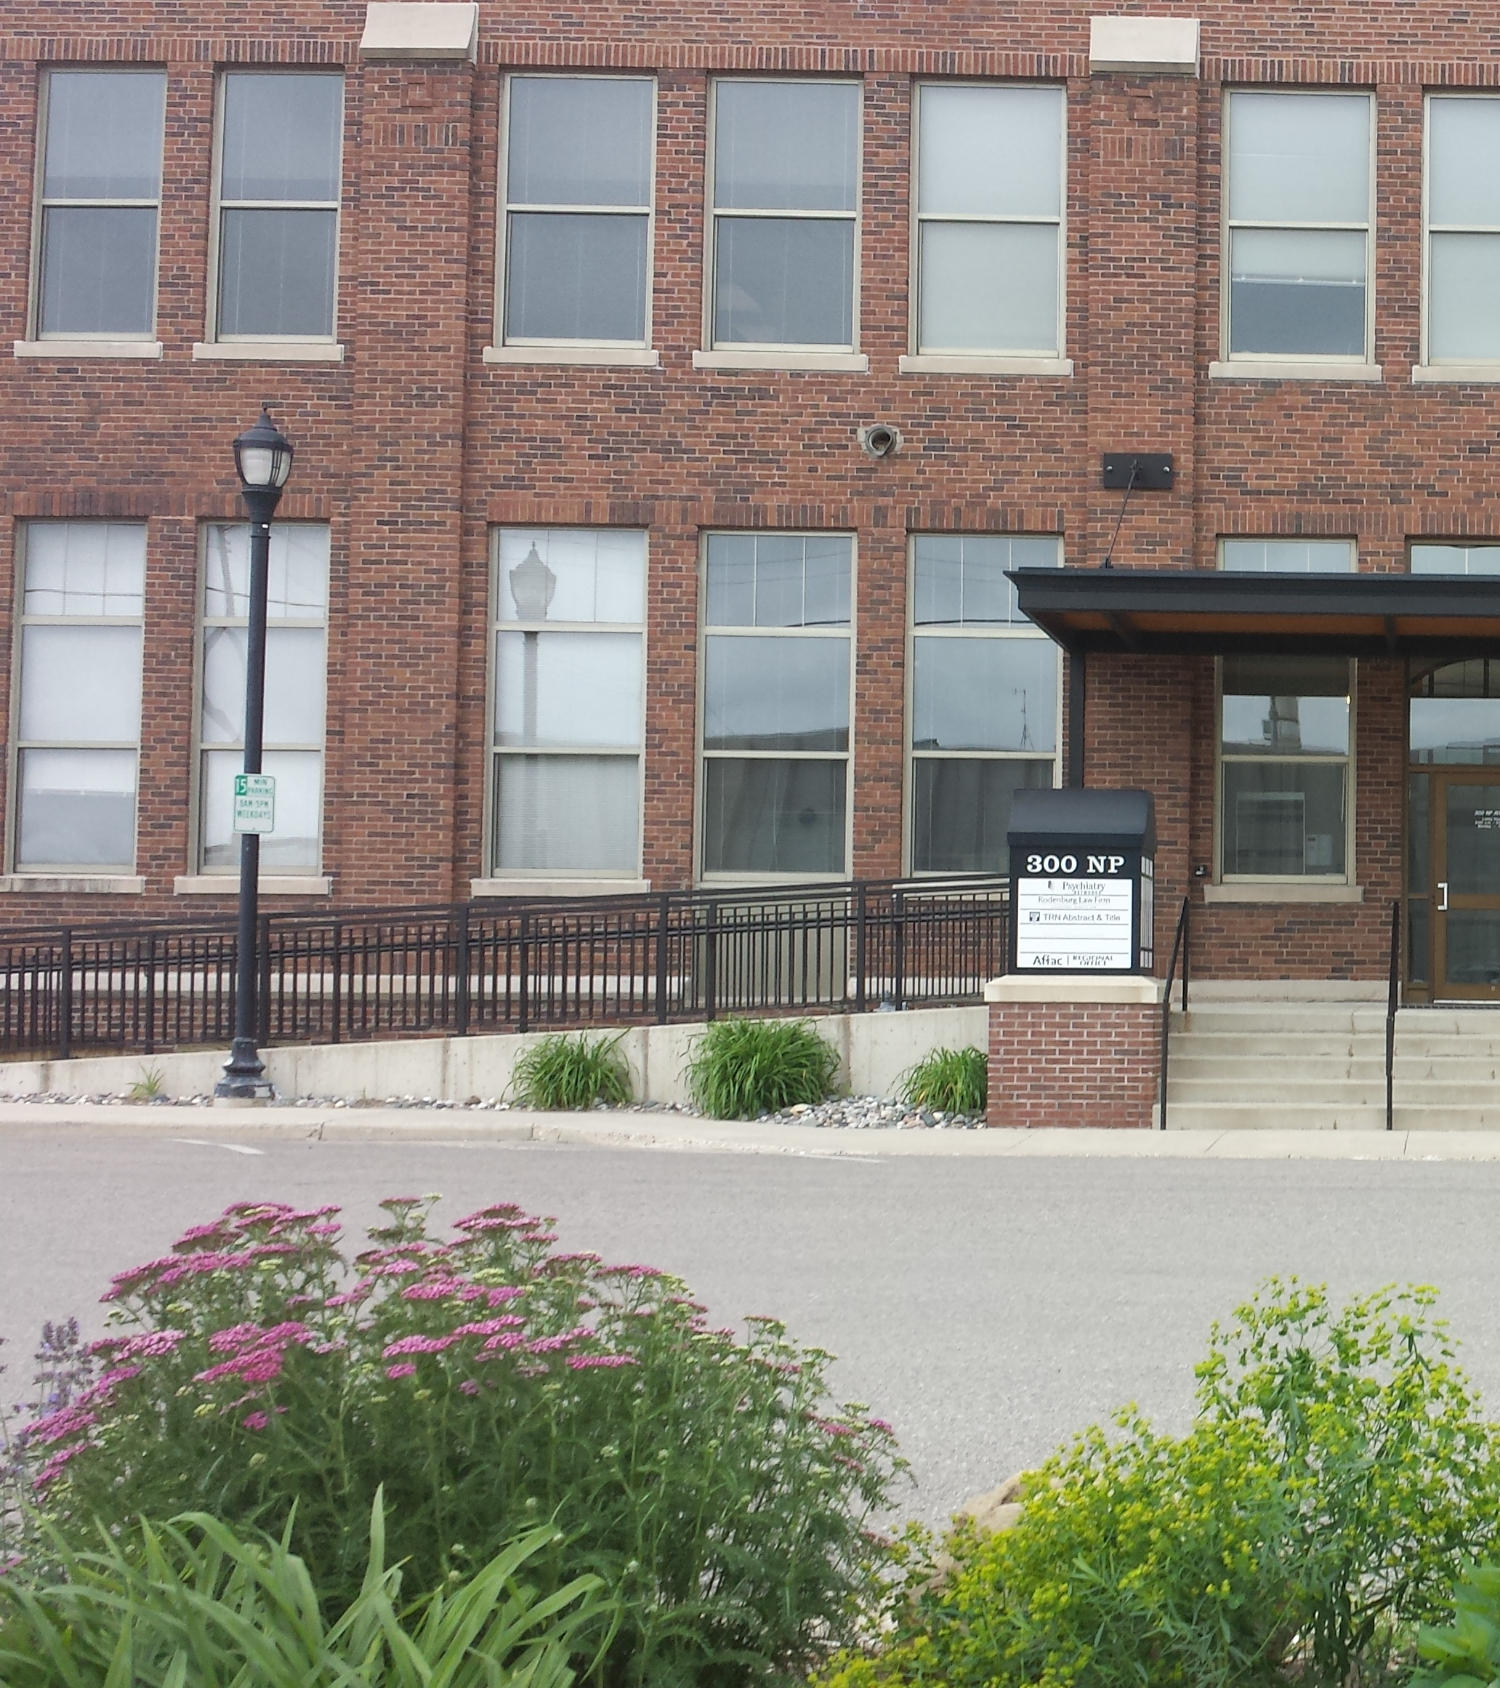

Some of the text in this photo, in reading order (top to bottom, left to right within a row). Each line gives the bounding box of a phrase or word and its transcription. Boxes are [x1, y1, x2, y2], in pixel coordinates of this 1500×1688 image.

[236, 779, 246, 793] 15
[1026, 855, 1125, 874] 300 NP
[1062, 881, 1106, 892] Psychiatry
[1044, 913, 1061, 921] TRN
[1063, 913, 1095, 921] Abstract
